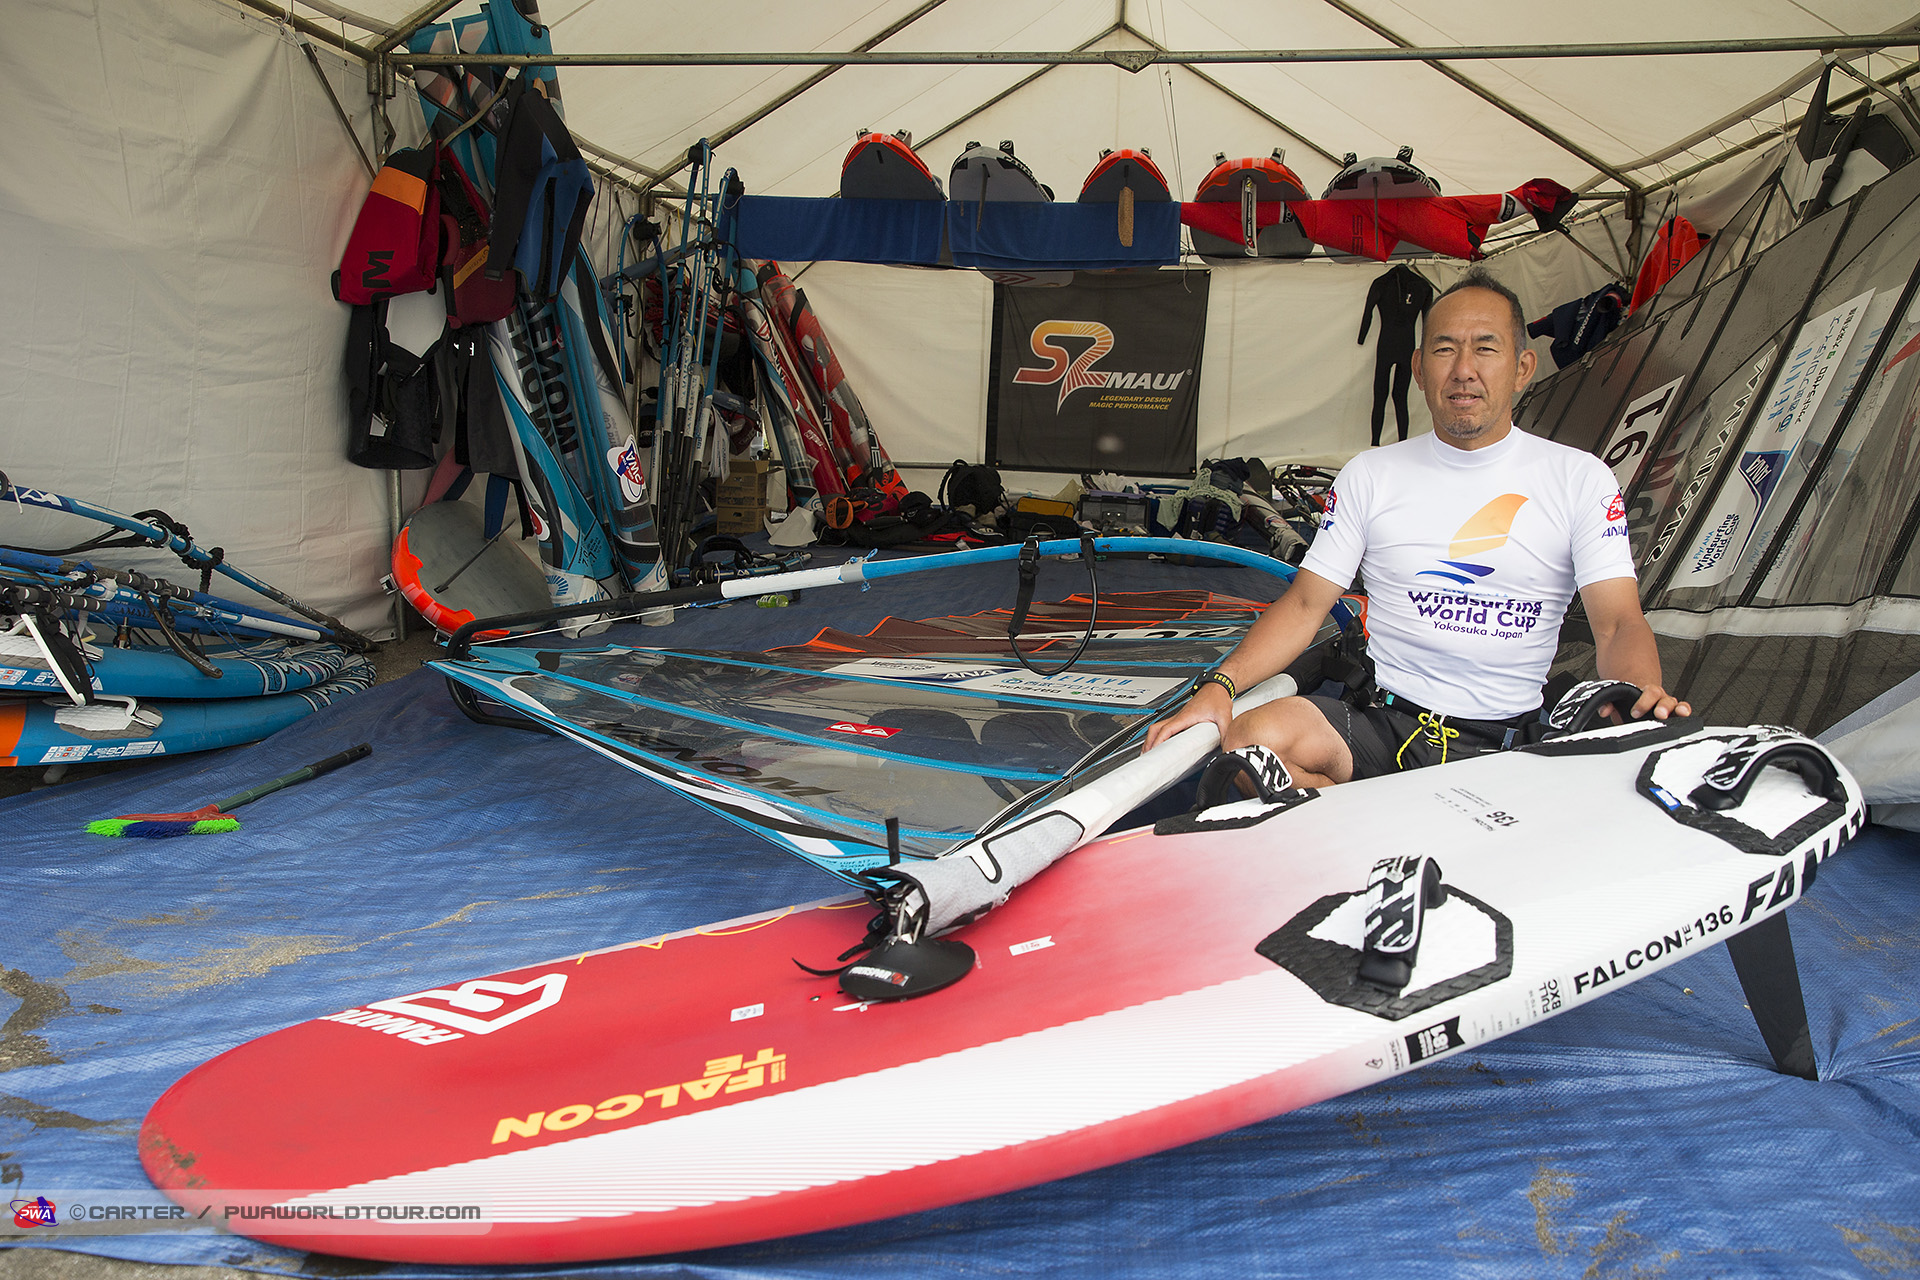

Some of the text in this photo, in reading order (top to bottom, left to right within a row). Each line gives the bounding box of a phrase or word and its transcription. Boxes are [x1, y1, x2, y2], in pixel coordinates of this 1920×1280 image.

[1104, 370, 1185, 391] MAUI
[1767, 347, 1813, 421] KEIKYU
[1089, 401, 1169, 411] MAGIC PERFORMANCE
[1100, 394, 1172, 404] LEGENDARY DESIGN
[1745, 454, 1773, 486] ANA
[1691, 513, 1736, 574] Windsurfing
[1702, 530, 1715, 546] ANA
[1703, 514, 1740, 570] World Cup
[1407, 590, 1544, 617] Windsurfing
[1418, 603, 1537, 633] World Cup
[1433, 620, 1523, 641] Yokosuka Japan
[942, 668, 999, 680] ANA
[1486, 811, 1519, 827] 136
[1573, 930, 1683, 996] FALCON
[1694, 904, 1734, 937] 136
[1539, 981, 1550, 1015] FULL
[1547, 979, 1562, 1010] BXC
[702, 1047, 787, 1078] TE
[491, 1065, 765, 1144] FALCON
